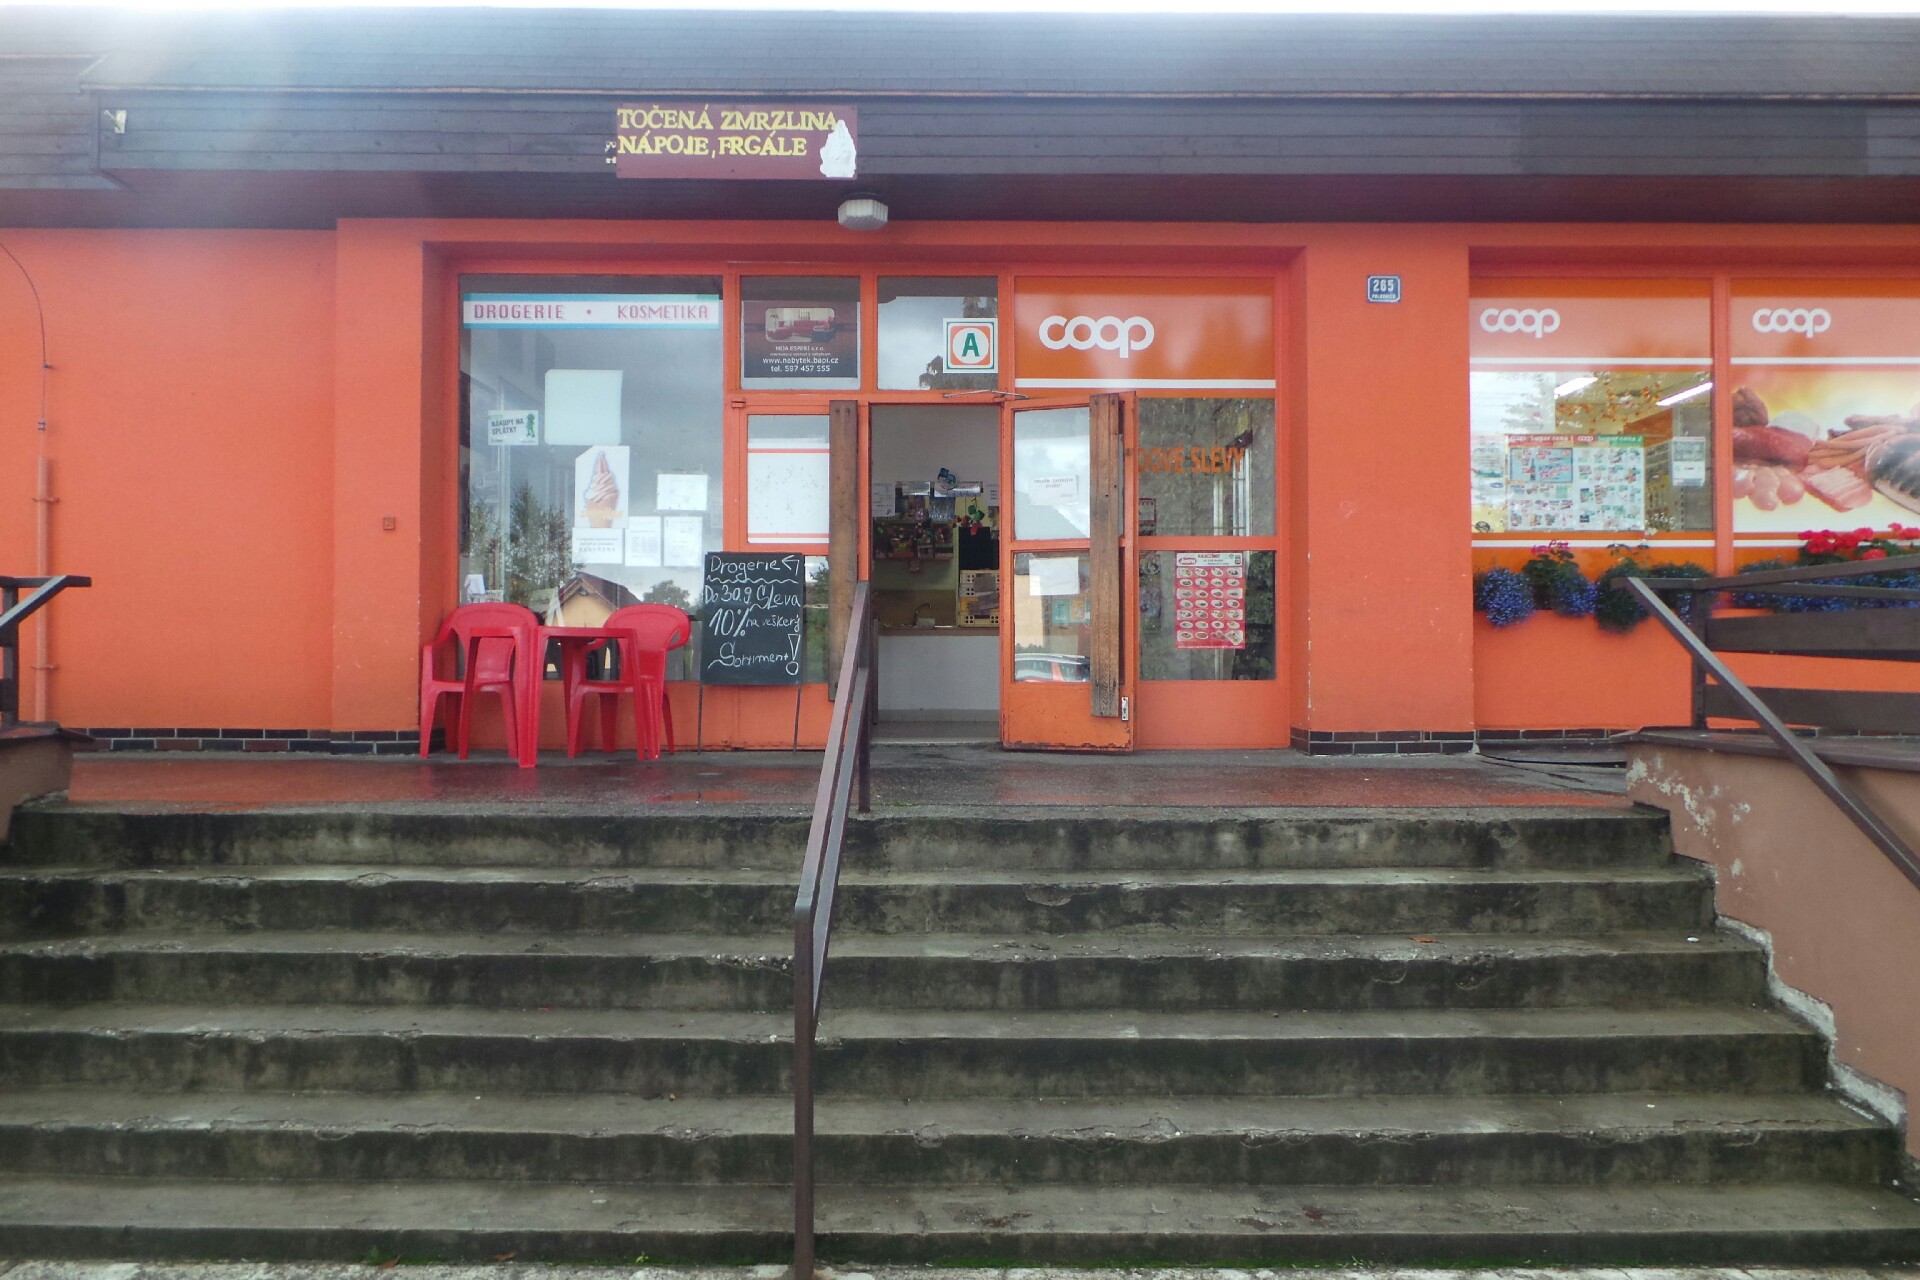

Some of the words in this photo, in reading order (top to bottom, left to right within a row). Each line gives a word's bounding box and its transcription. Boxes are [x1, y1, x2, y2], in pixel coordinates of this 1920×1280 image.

[617, 104, 713, 130] TOČENÁ
[720, 111, 836, 131] ZMRZLINA
[718, 131, 808, 156] FRGÁLE
[473, 304, 565, 319] DROGERIE
[617, 304, 709, 319] KOSMETIKA
[1480, 308, 1561, 338] coop
[1752, 308, 1831, 338] coop
[962, 332, 981, 357] A
[1038, 315, 1155, 359] coop
[1190, 446, 1245, 473] SLEVY
[711, 555, 781, 583] Drogerie
[705, 585, 719, 605] Do
[708, 608, 750, 637] 10%
[746, 618, 759, 628] na
